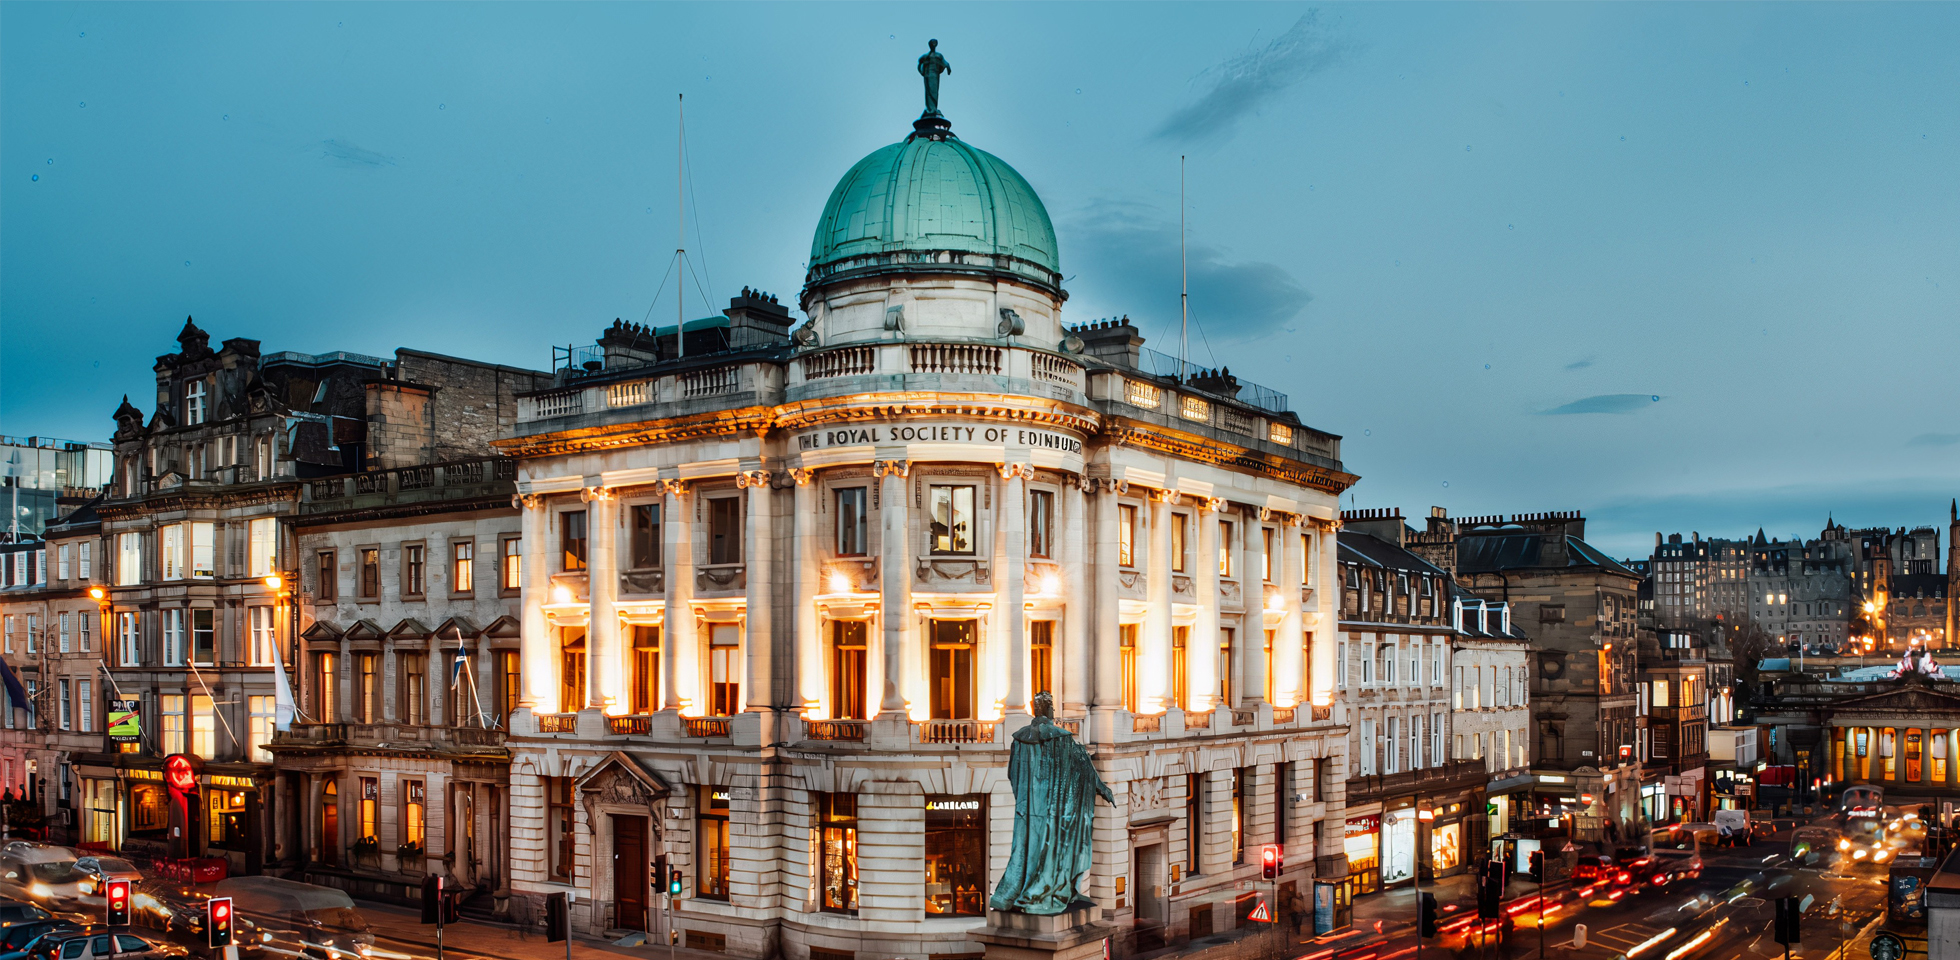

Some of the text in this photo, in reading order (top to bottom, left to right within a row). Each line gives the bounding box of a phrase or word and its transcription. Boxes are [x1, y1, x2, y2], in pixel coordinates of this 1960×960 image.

[798, 426, 1081, 455] THE ROYAL SOCIETY OF EDINBUR
